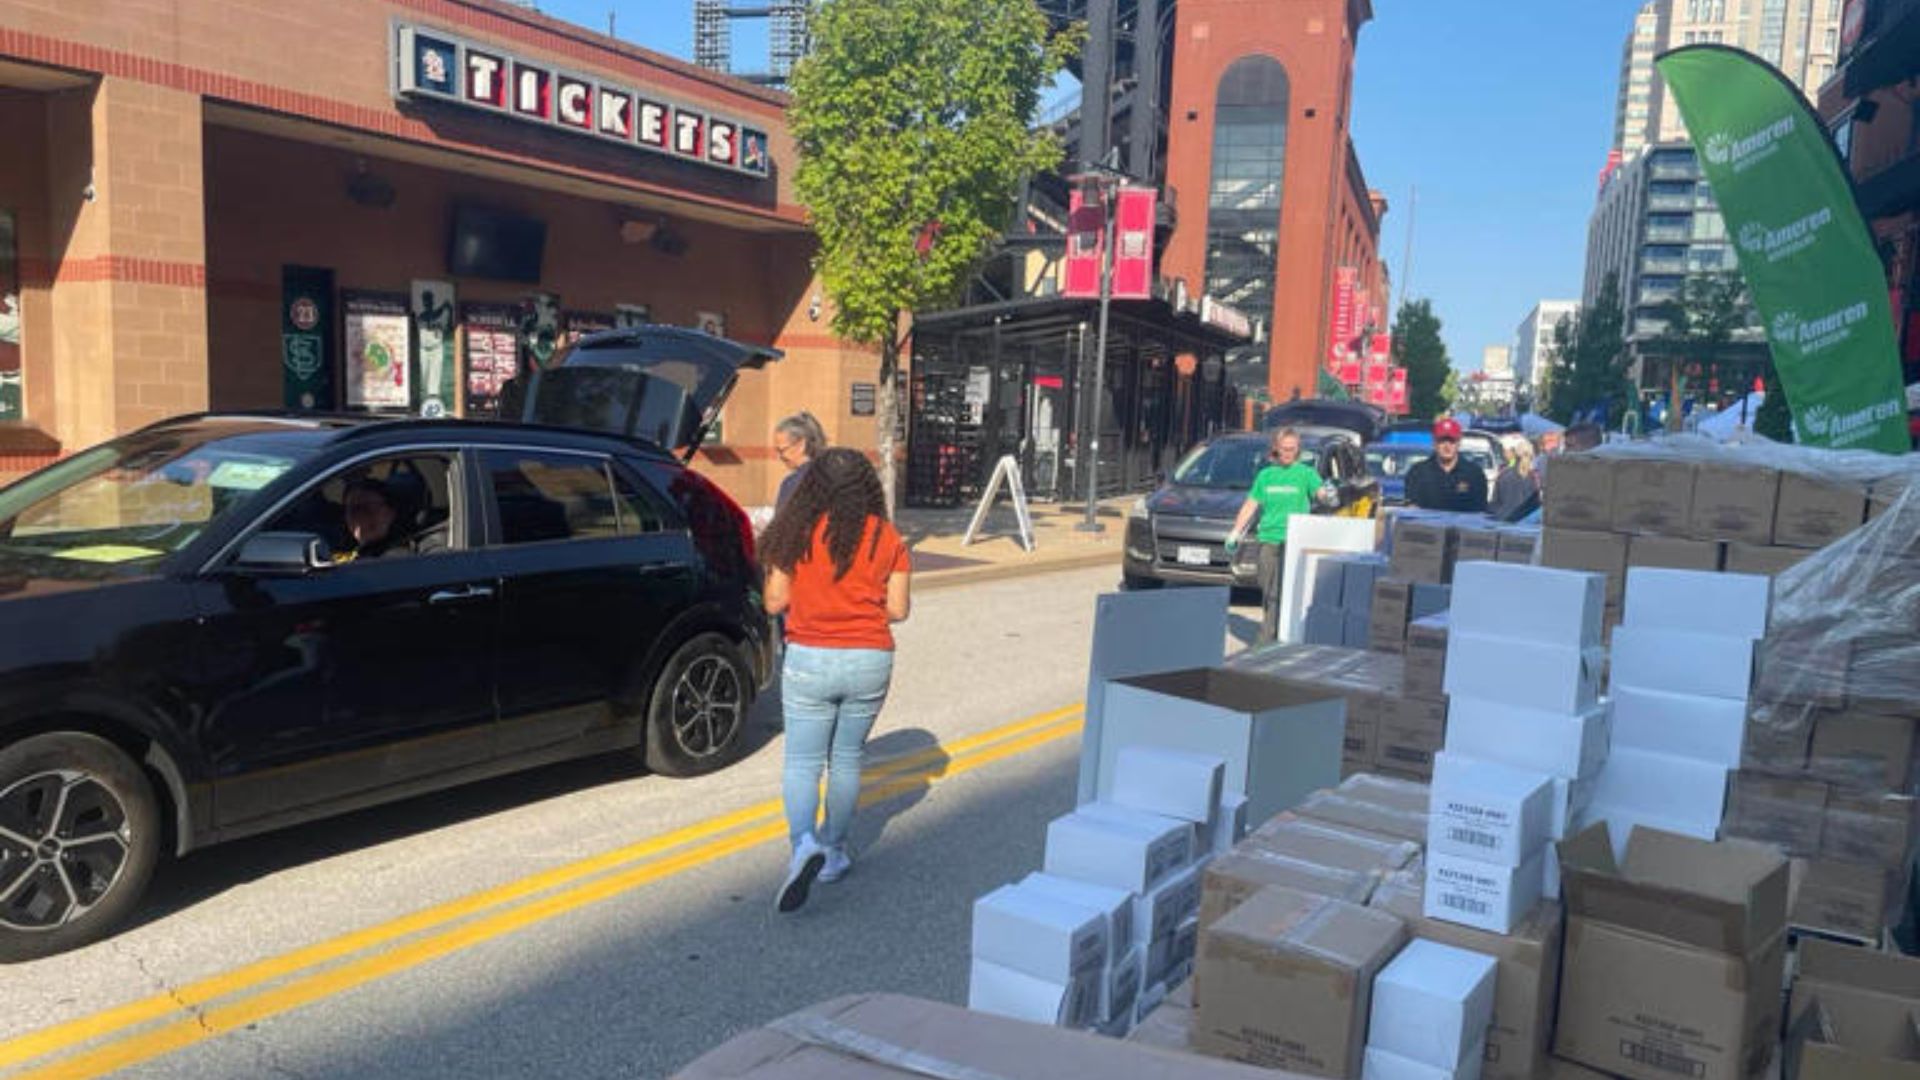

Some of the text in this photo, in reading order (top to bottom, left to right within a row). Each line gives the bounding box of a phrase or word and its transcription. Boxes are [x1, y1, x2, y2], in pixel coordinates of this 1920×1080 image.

[470, 55, 732, 161] TICKETS
[1799, 302, 1868, 343] Ameren
[1830, 400, 1900, 439] Ameren
